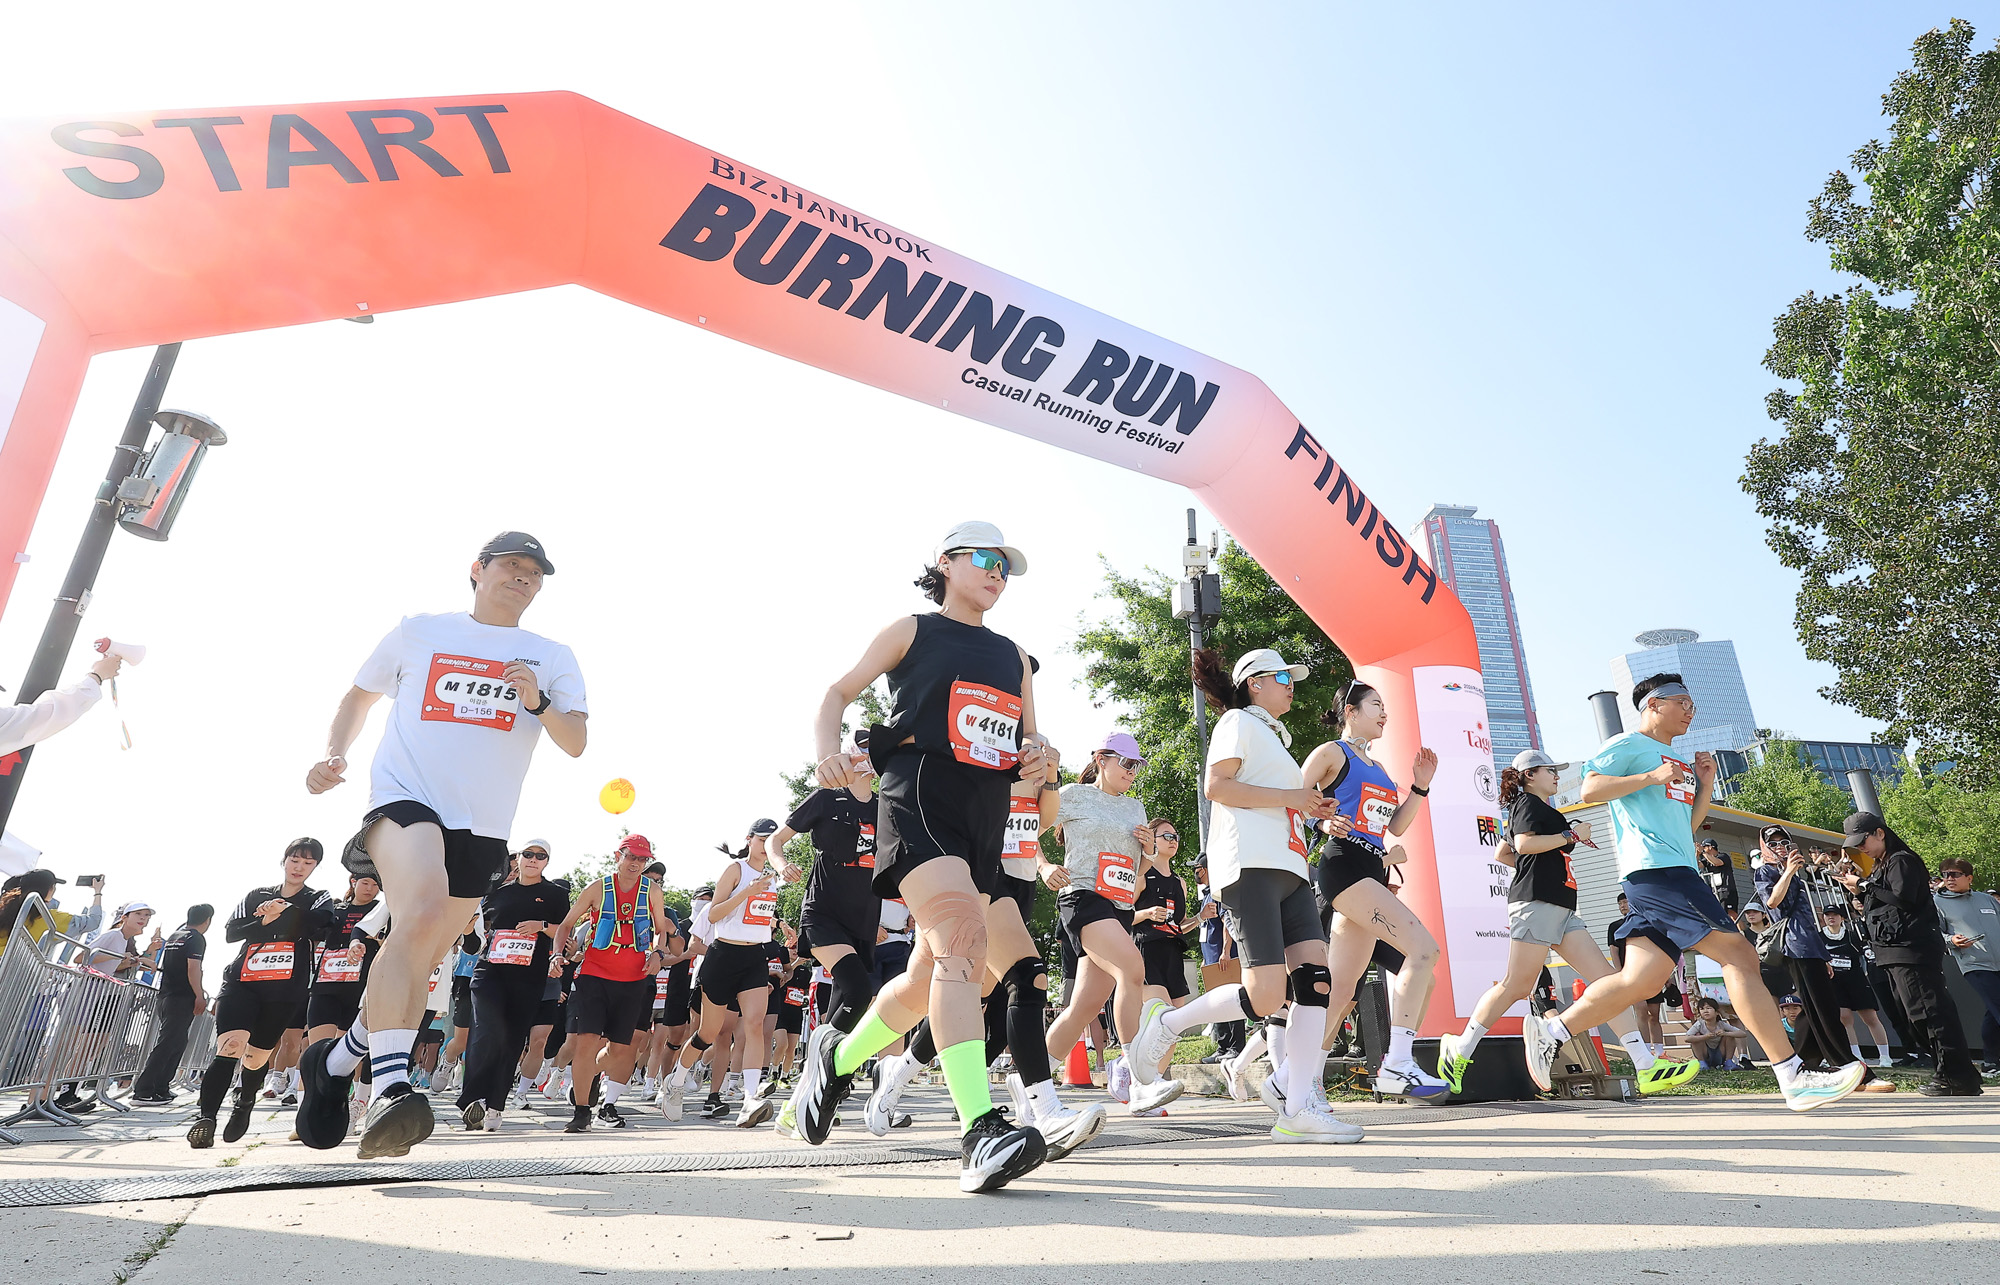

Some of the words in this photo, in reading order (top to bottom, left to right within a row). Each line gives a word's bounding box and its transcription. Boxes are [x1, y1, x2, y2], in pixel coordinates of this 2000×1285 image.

[50, 103, 511, 200] START
[659, 182, 1065, 382] BURNING
[1063, 338, 1220, 436] RUN
[961, 366, 1031, 405] Casual
[1034, 392, 1113, 435] Running
[1115, 421, 1184, 455] Festival
[1284, 422, 1437, 606] FINISH
[436, 657, 471, 668] BURNING
[471, 662, 490, 671] RUN
[444, 681, 460, 692] M
[466, 681, 517, 701] 1815
[956, 687, 987, 699] BURNING
[460, 706, 492, 716] D-156
[966, 714, 978, 727] W
[979, 716, 1013, 740] 4181
[974, 746, 996, 762] B-138
[1367, 803, 1375, 812] W
[1005, 818, 1038, 831] 4100
[1479, 831, 1503, 847] KIN
[1108, 870, 1116, 878] W
[1487, 863, 1508, 876] TOUS
[1475, 930, 1495, 938] World
[508, 942, 533, 951] 3793
[251, 957, 260, 965] W
[261, 954, 292, 964] 4552
